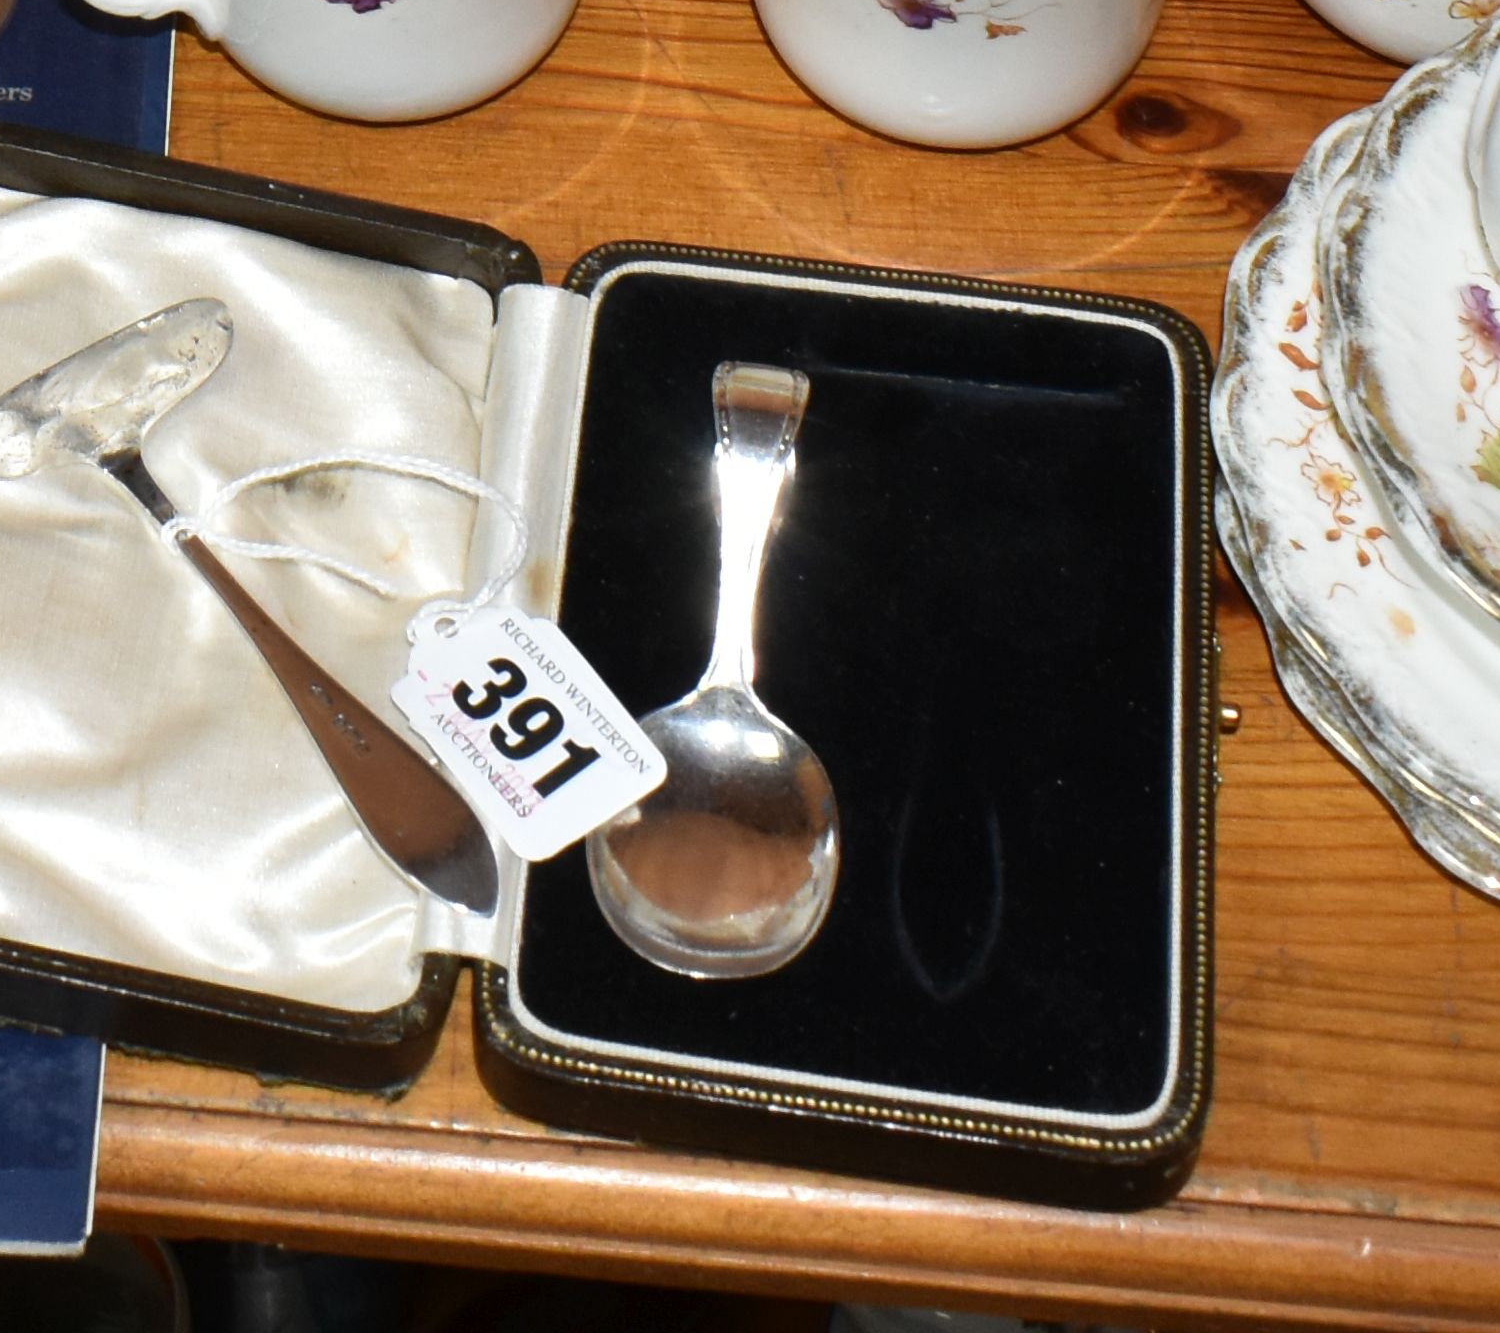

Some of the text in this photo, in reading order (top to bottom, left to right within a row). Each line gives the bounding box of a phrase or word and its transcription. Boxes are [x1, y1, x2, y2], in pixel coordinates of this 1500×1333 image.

[431, 712, 532, 818] AUCTIONEERS
[452, 658, 601, 799] 391
[500, 618, 650, 774] RICHARD WINTERTON
